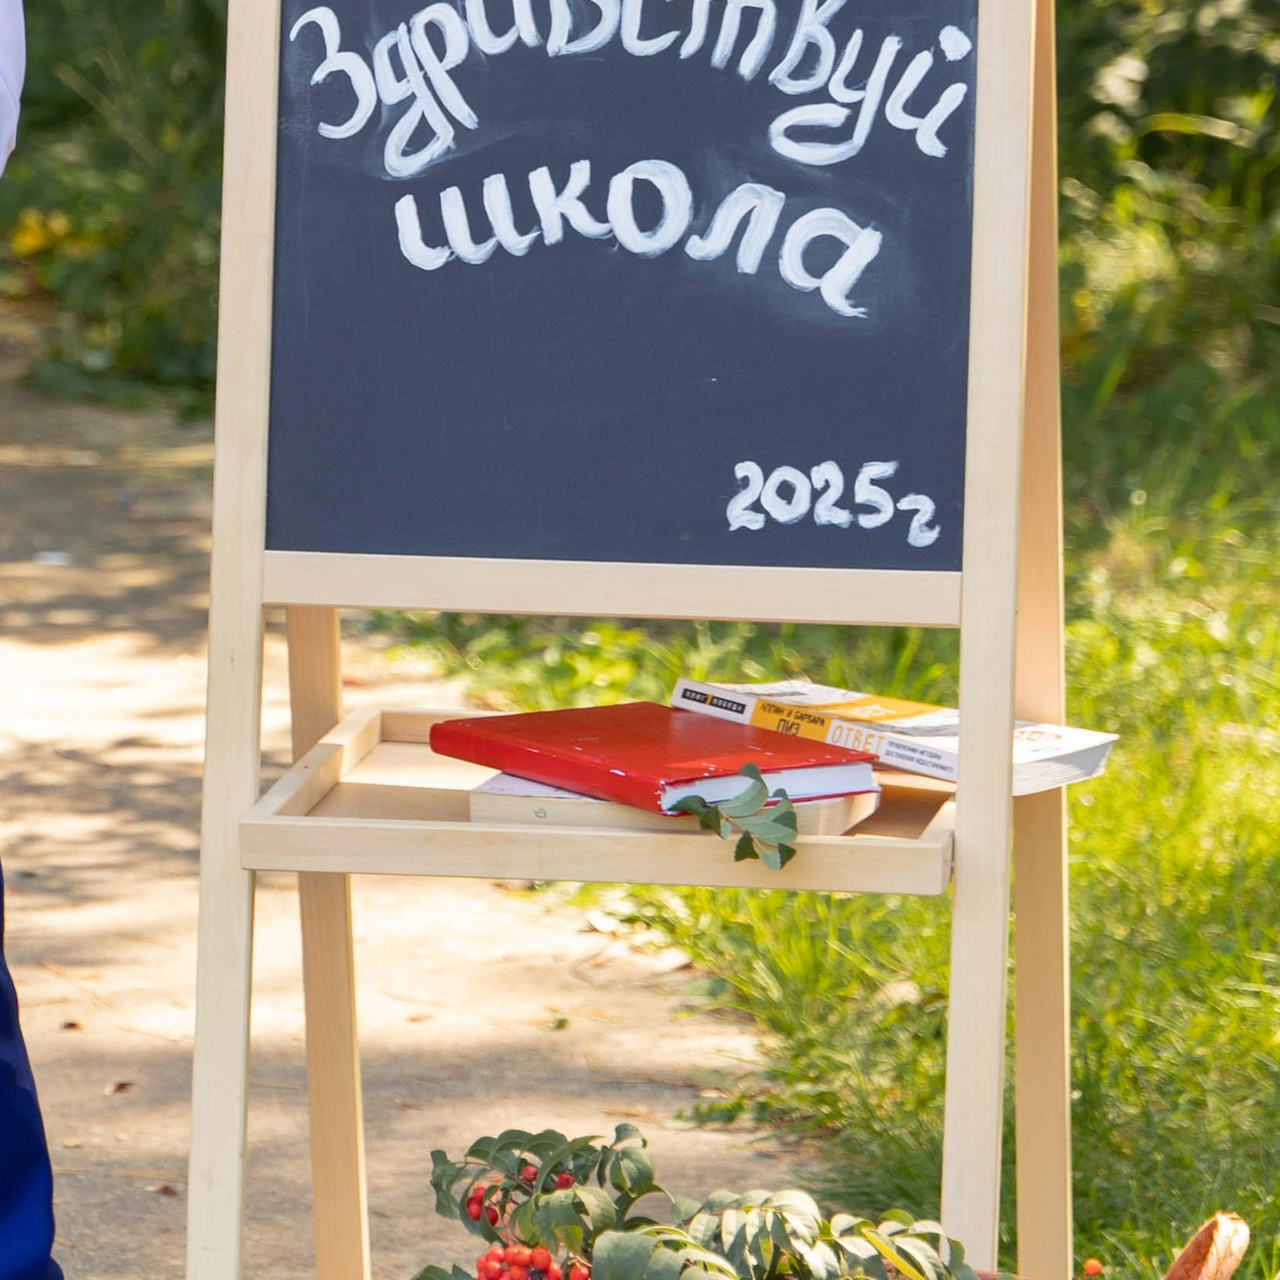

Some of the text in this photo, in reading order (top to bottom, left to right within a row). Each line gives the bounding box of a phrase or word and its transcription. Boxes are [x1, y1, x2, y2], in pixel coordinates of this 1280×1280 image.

[394, 159, 883, 318] школа
[776, 718, 801, 736] ПИЗ
[830, 724, 886, 756] ОТВЕТ
